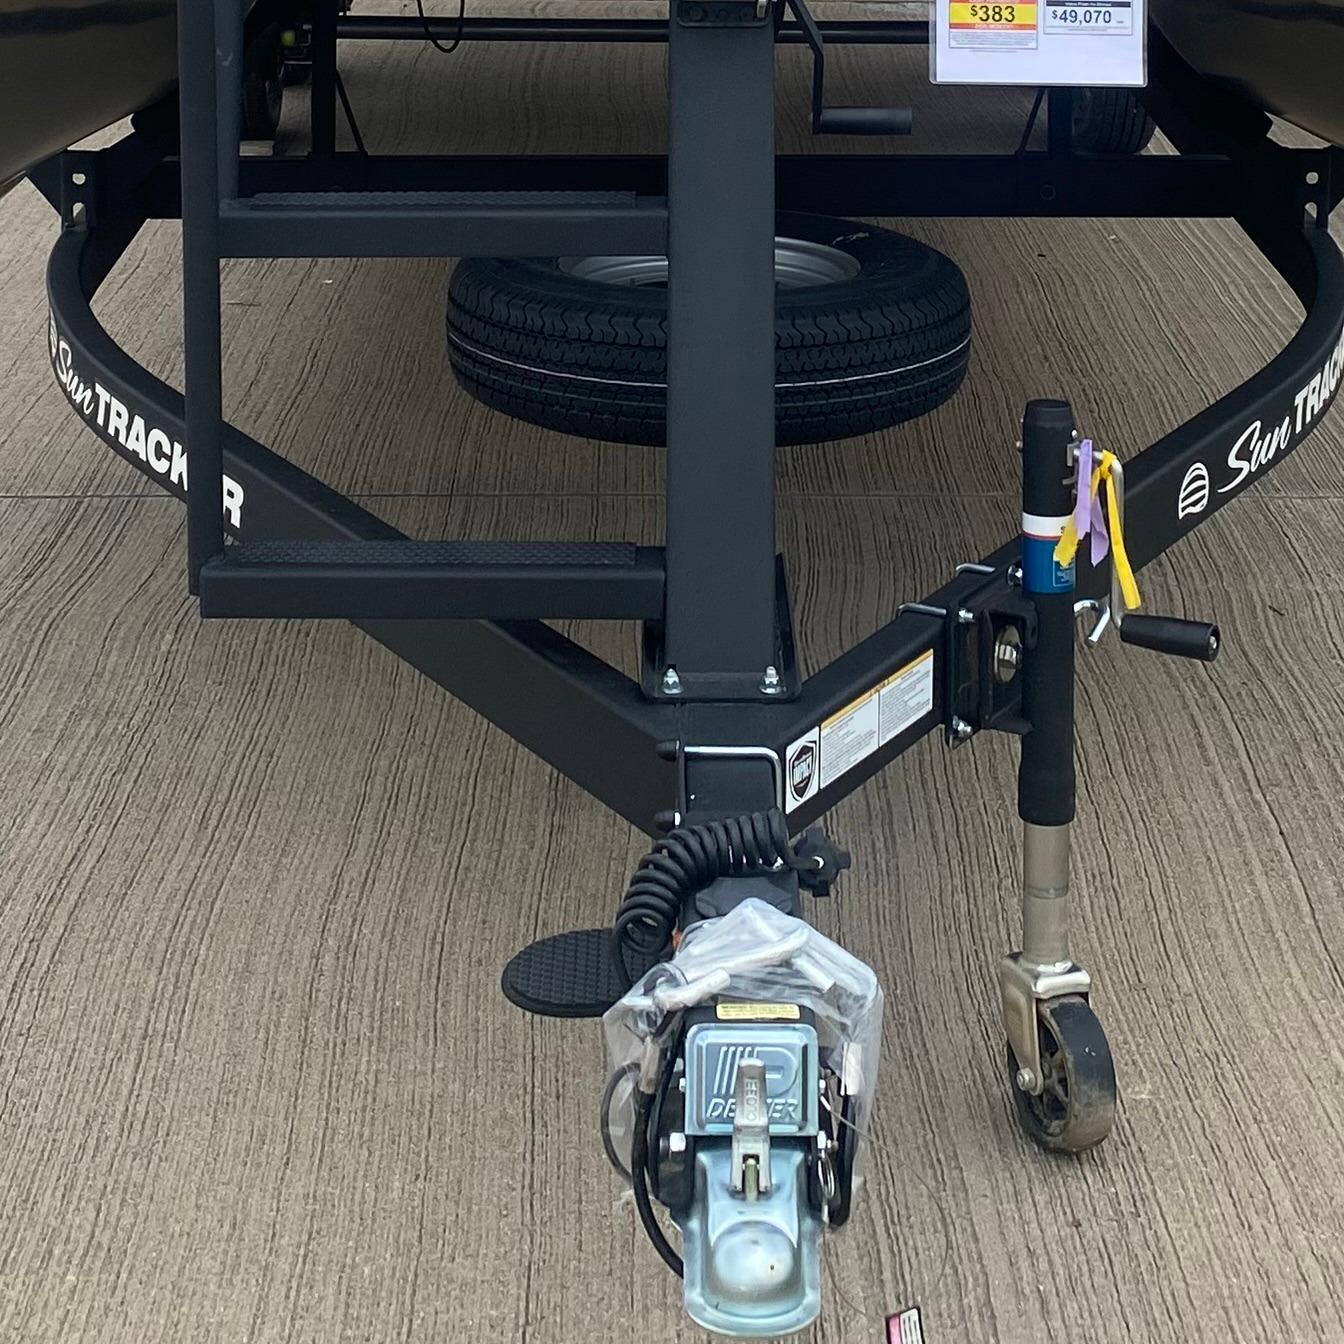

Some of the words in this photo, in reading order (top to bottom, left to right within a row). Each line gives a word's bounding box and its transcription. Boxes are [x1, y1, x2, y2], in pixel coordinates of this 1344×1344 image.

[970, 4, 1016, 23] $383
[1051, 9, 1112, 25] $49,070
[56, 340, 94, 415] Sun
[95, 382, 244, 529] TRACKR
[1217, 416, 1293, 493] Sun
